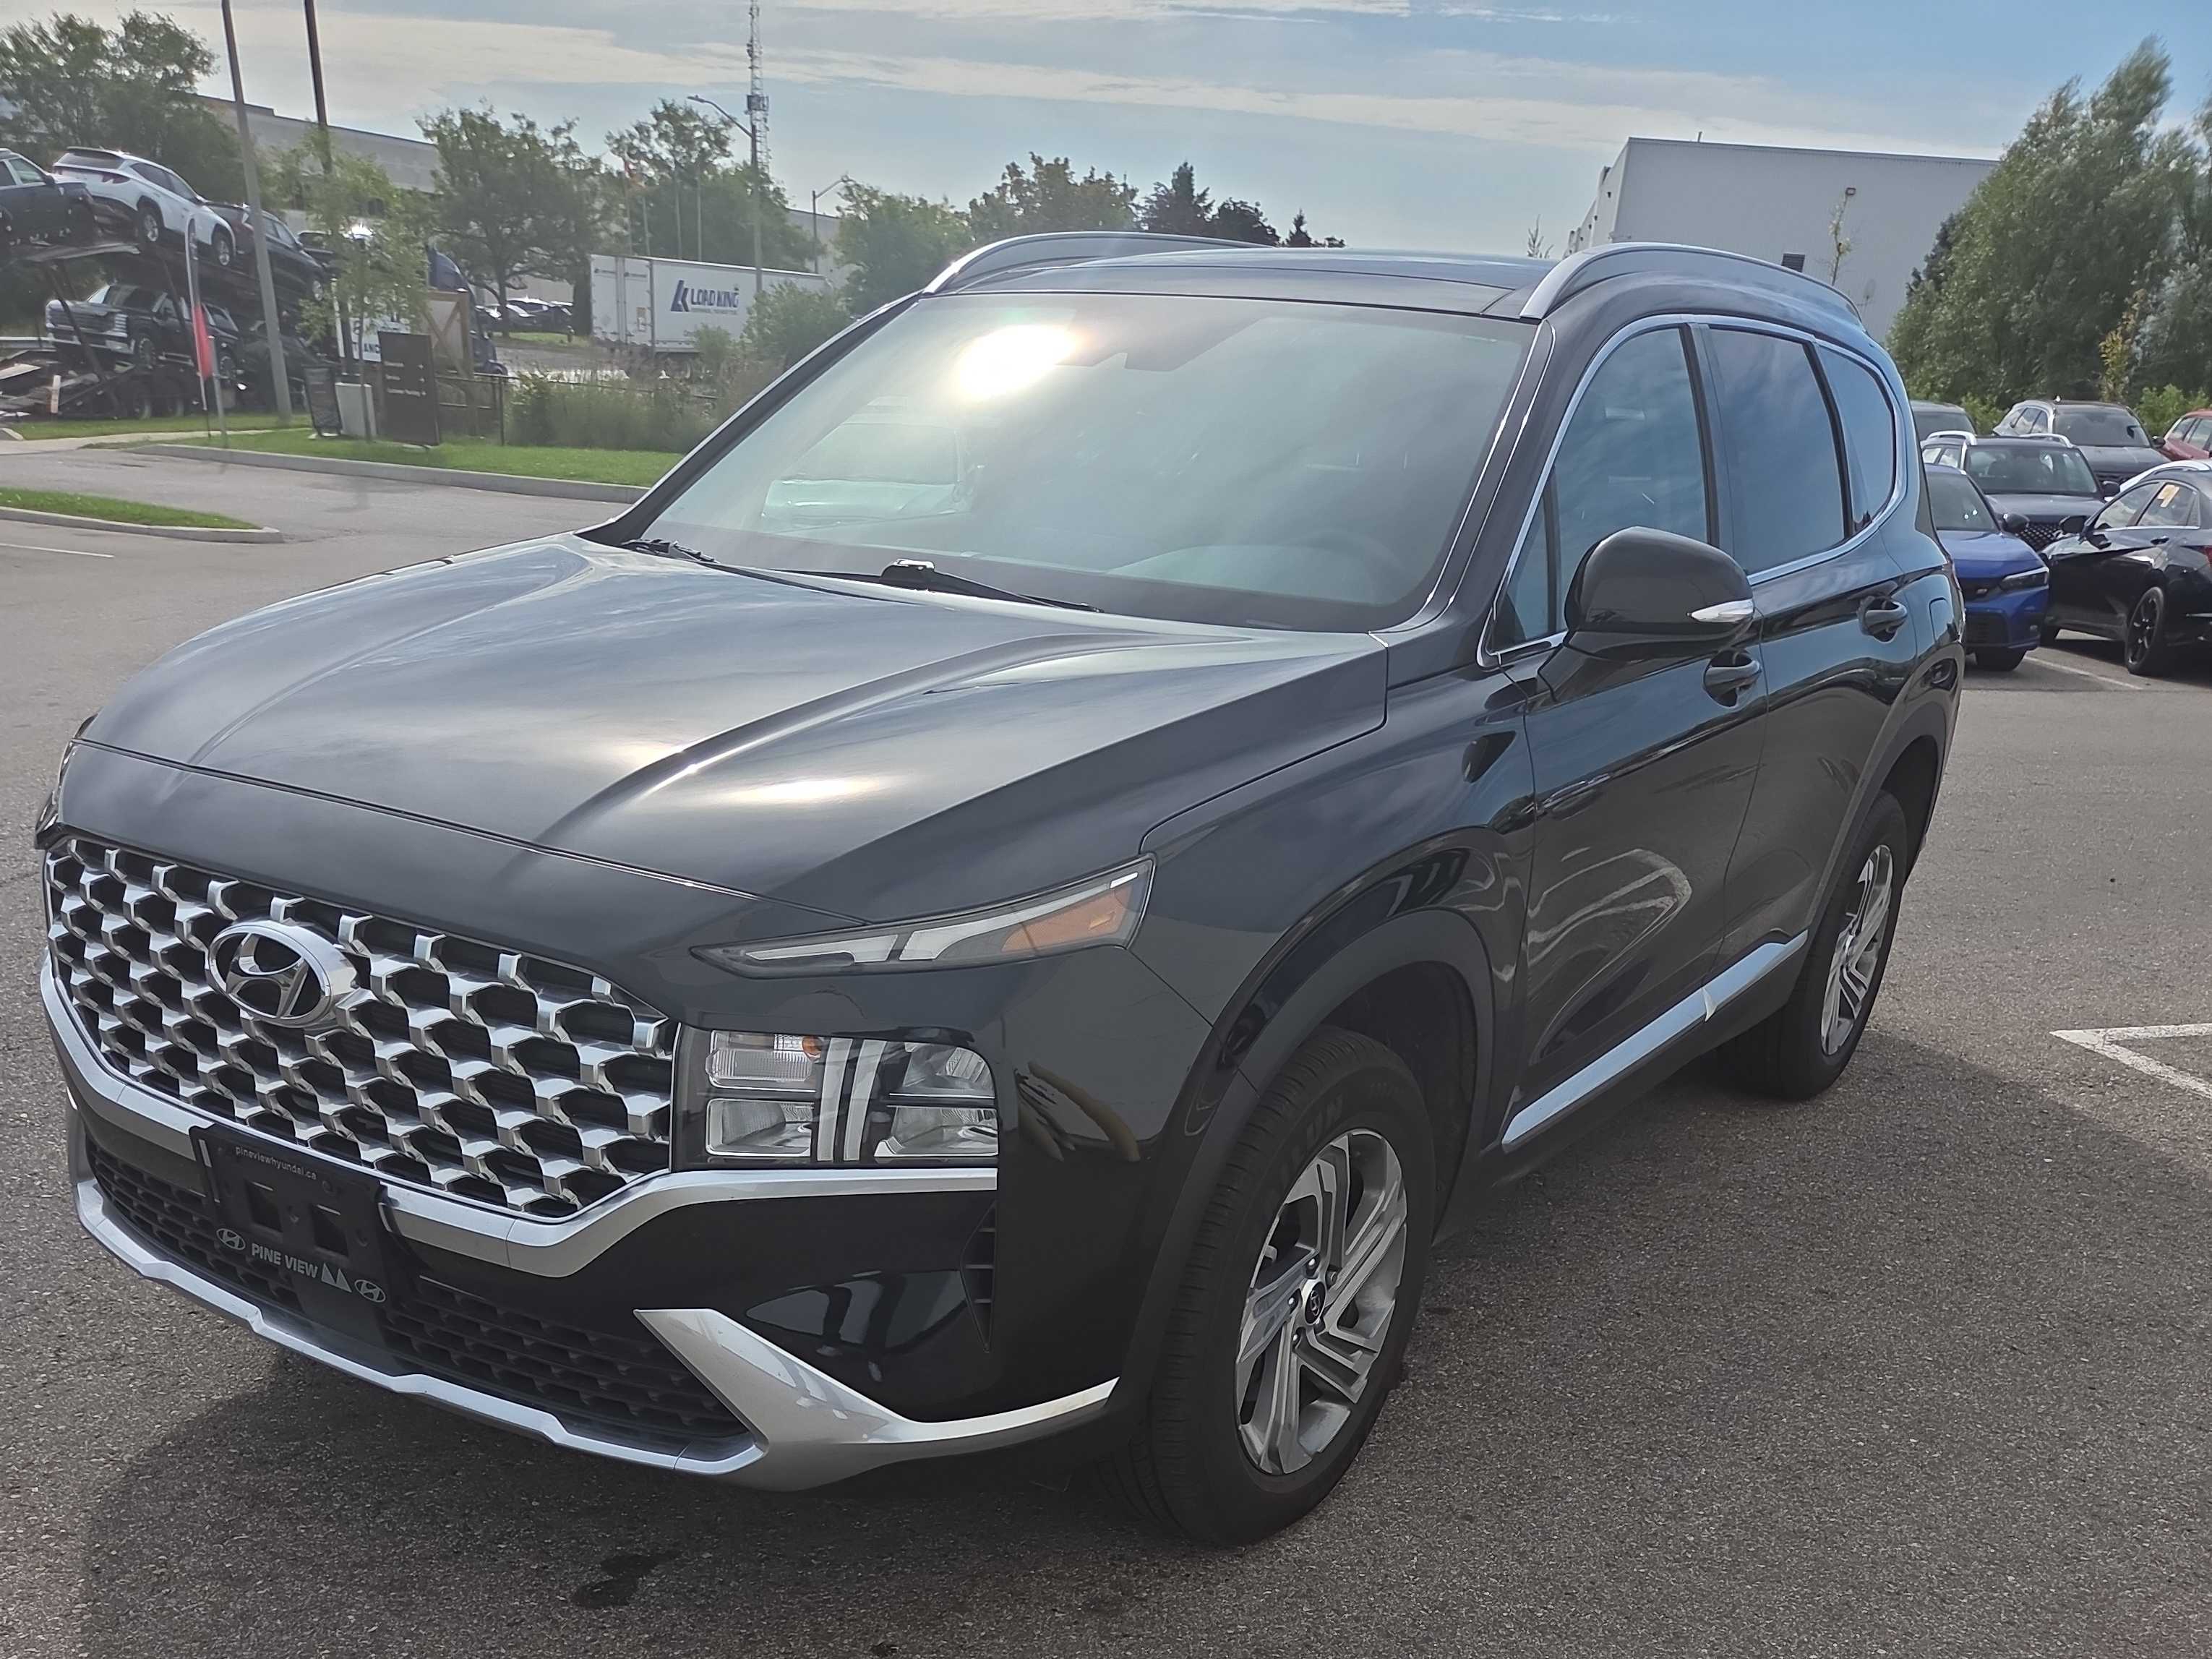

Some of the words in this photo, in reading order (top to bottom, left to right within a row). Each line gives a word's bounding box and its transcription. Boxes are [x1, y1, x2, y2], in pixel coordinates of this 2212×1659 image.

[690, 288, 716, 306] LOAD
[252, 1243, 281, 1265] PINE
[285, 1254, 318, 1278] VIEW
